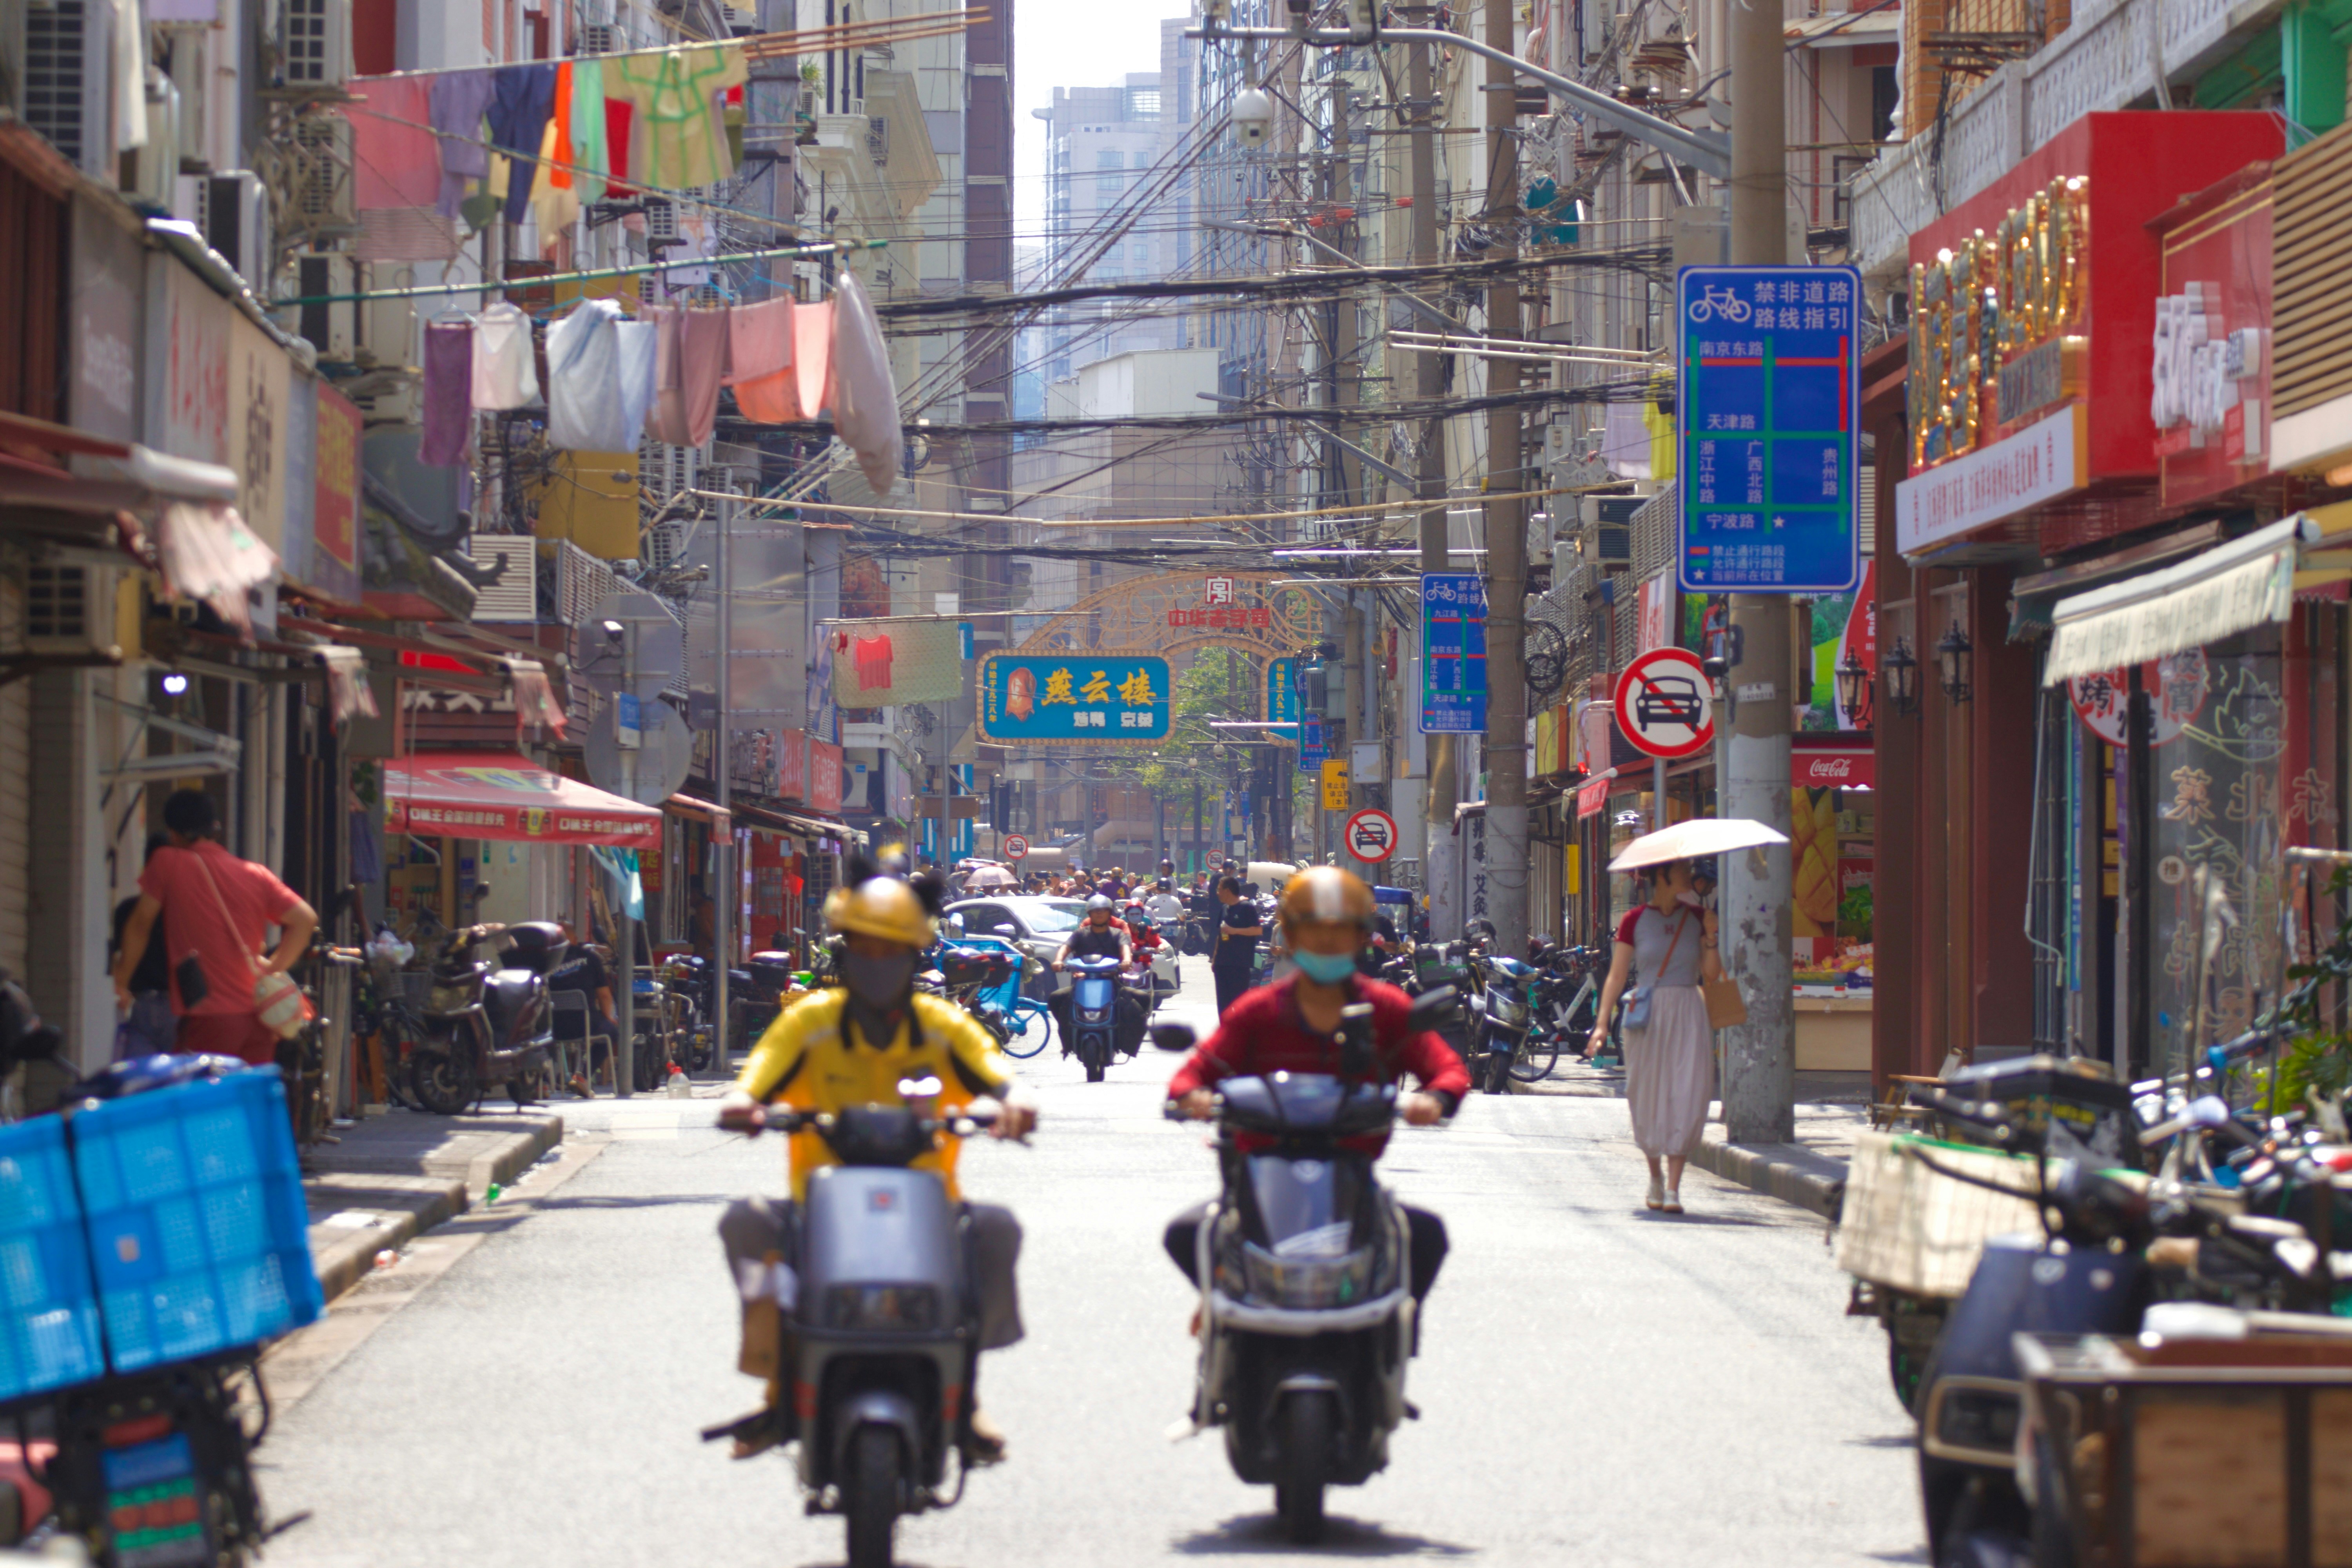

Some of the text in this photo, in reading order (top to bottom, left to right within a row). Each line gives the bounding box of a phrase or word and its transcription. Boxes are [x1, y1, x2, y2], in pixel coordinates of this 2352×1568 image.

[1755, 281, 1849, 303] 禁非道路
[1755, 307, 1848, 329] 路线指引
[1699, 341, 1764, 356] 南京东路
[1707, 414, 1755, 430] 天津路
[1699, 441, 1715, 503] 浙江中路
[1747, 441, 1763, 504] 广西北路
[1822, 448, 1838, 496] 贵州路
[1706, 514, 1755, 529] 宁波路
[1712, 545, 1785, 556] 禁止通行路段
[1712, 557, 1785, 569] 允许通行路段
[1711, 570, 1784, 582] 当前所在位置
[1453, 659, 1461, 690] 广西北路
[1041, 667, 1157, 708] 燕云楼
[1433, 694, 1457, 703] 天津路
[1073, 711, 1153, 727] 烤鸭 京菜
[1473, 873, 1488, 916] 艾灸
